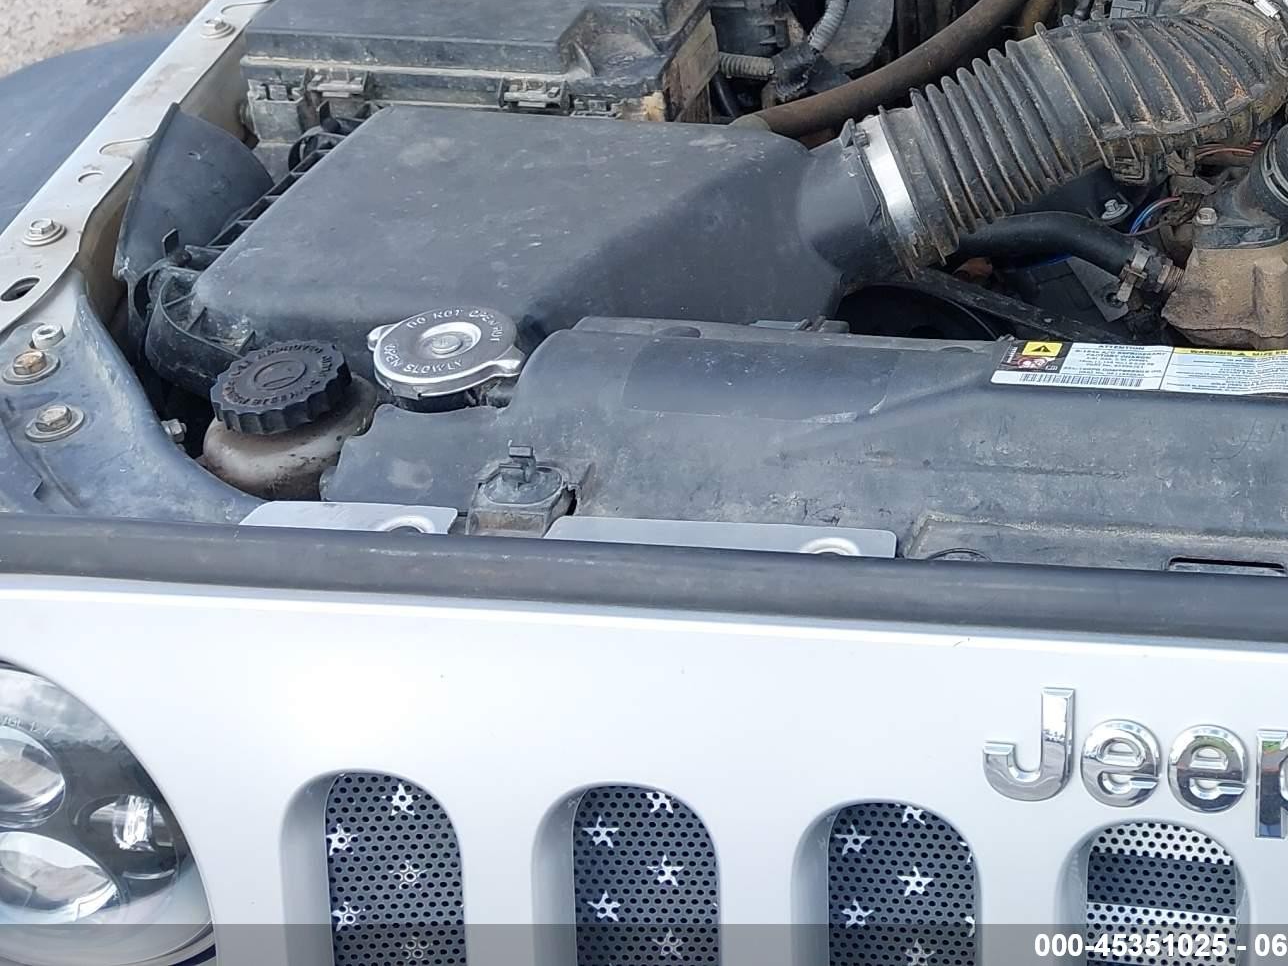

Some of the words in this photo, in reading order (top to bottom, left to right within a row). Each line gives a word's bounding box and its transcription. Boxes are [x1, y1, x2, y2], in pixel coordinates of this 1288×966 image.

[406, 316, 426, 329] DO
[433, 308, 464, 320] NOT
[383, 343, 402, 367] OPEN
[403, 359, 463, 374] SLOWLY
